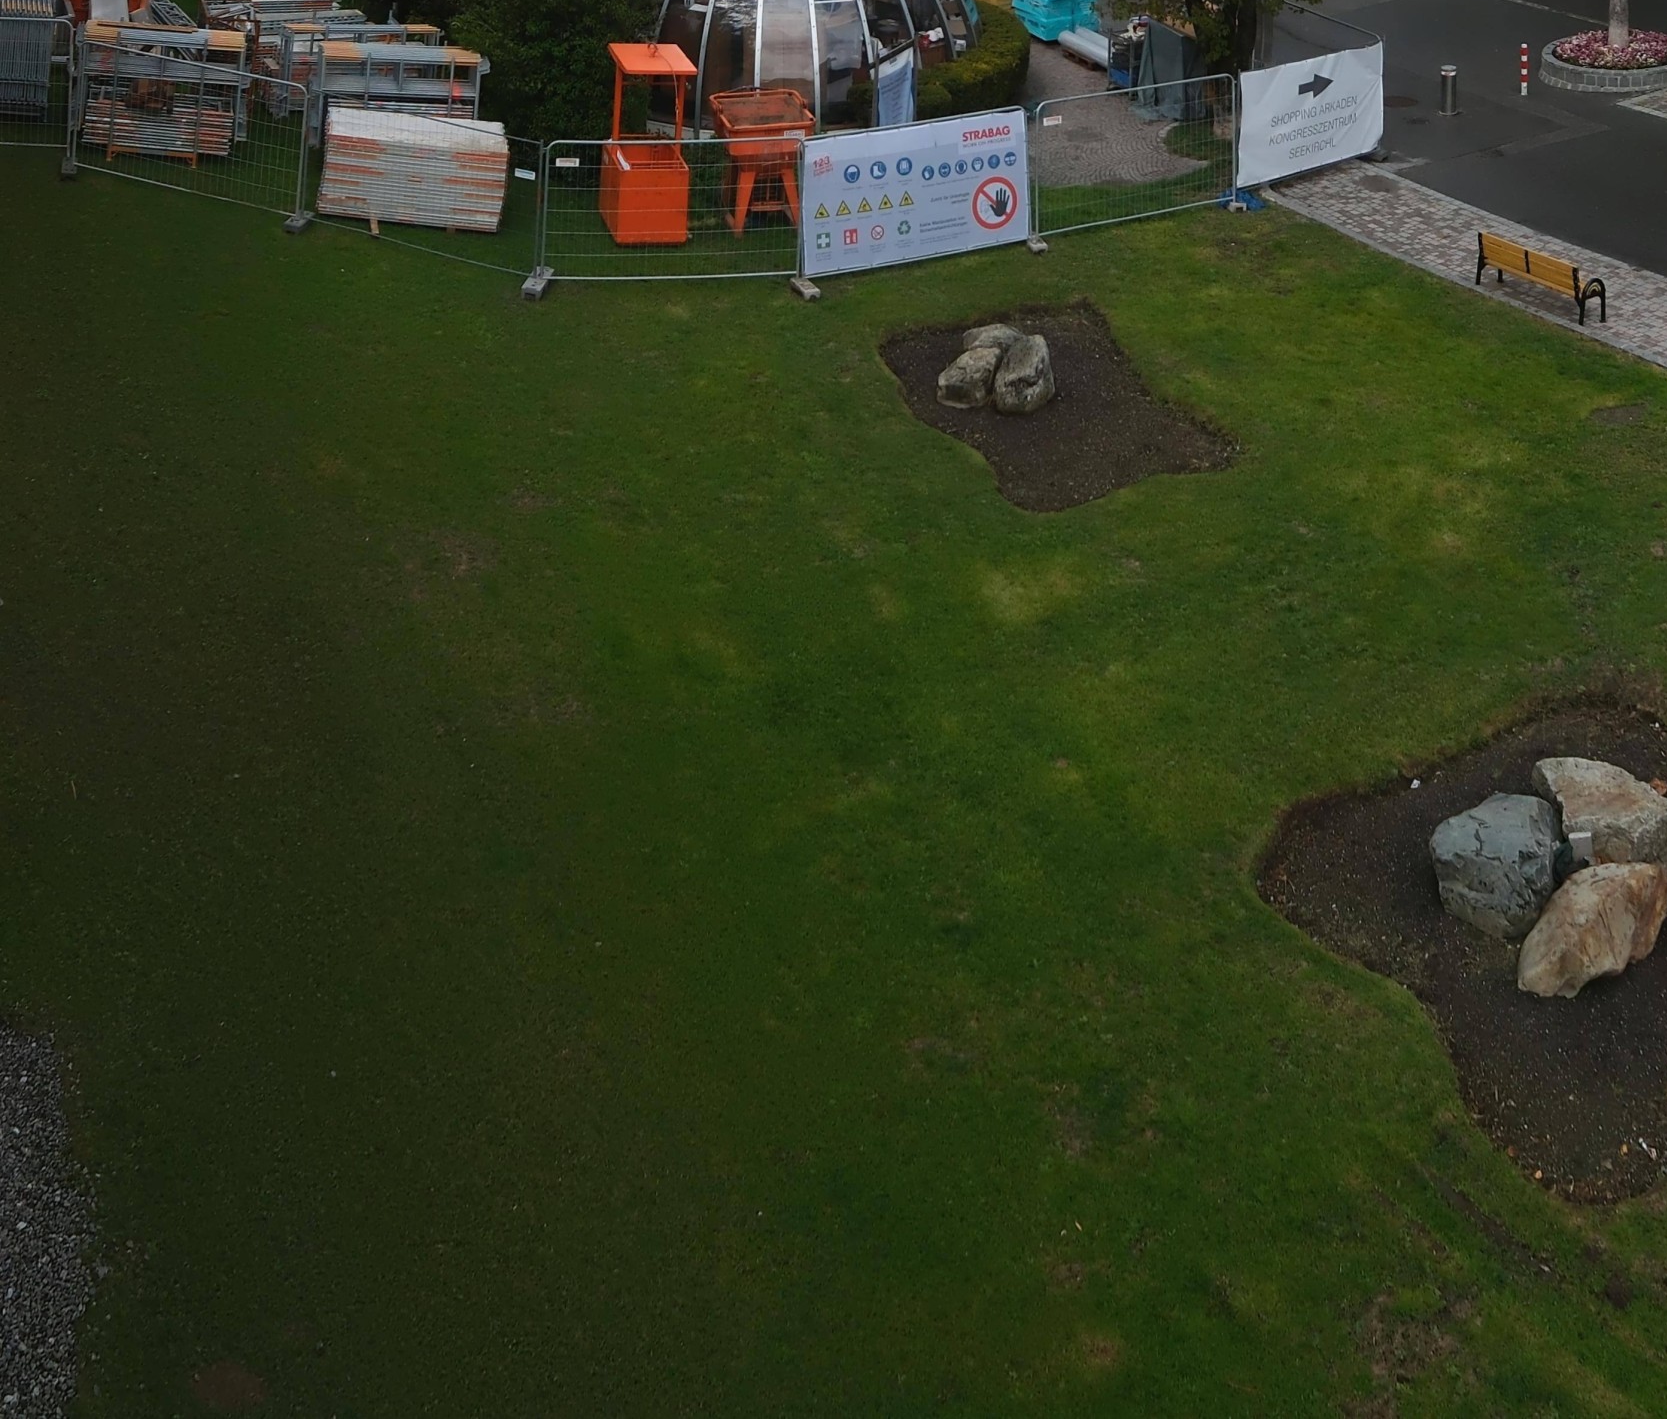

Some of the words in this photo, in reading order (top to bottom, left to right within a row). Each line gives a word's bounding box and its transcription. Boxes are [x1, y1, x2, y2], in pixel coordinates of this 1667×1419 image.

[1270, 106, 1317, 128] SHOPPING
[1318, 95, 1358, 116] ARKADEN
[962, 125, 1011, 142] STRABAG
[1268, 113, 1357, 147] KONGRESSZENTRUM
[1288, 137, 1336, 160] SEEKIRCHL
